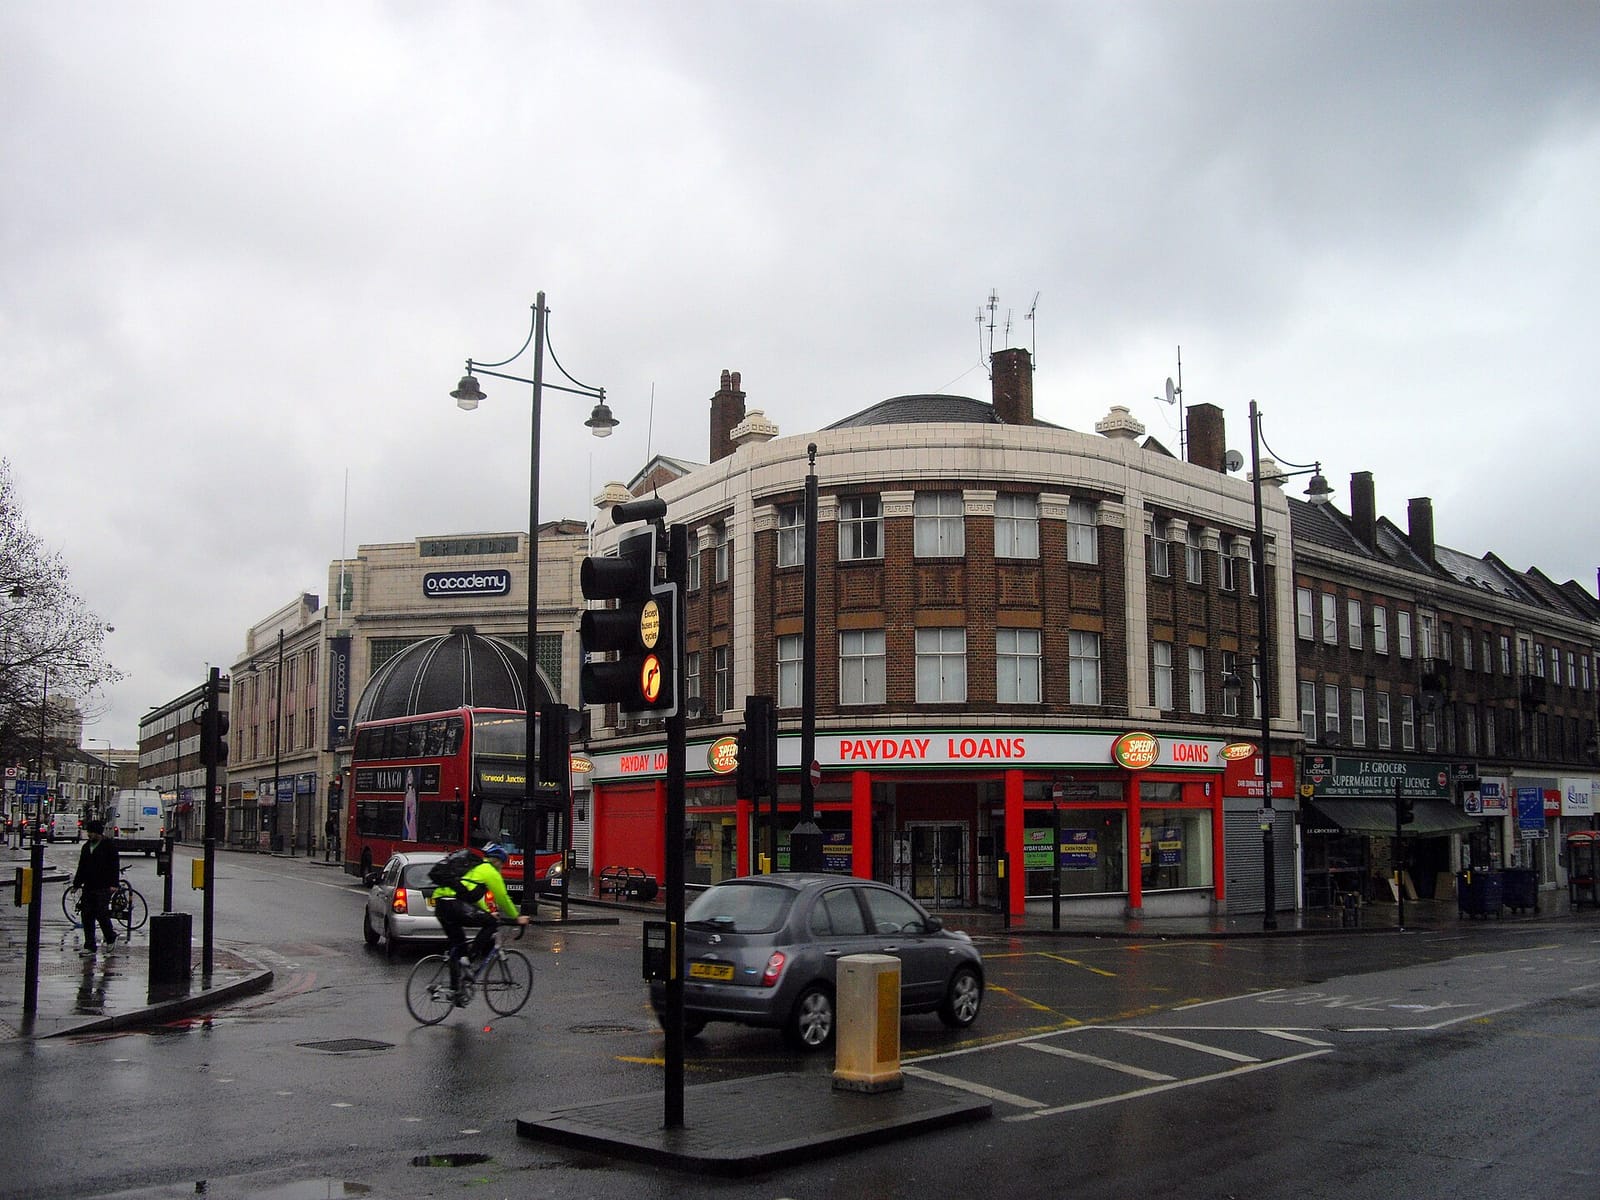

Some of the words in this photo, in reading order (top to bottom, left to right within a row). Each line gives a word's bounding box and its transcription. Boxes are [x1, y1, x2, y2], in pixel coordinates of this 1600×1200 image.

[840, 739, 930, 760] PAYDAY
[948, 738, 1026, 759] LOANS
[1129, 740, 1156, 753] SPEEDY
[1173, 743, 1209, 763] LOANS
[1130, 752, 1153, 762] CASH
[621, 755, 649, 773] PAYDAY
[1372, 762, 1407, 774] GROCERS
[376, 771, 402, 789] MANGO
[1332, 776, 1382, 787] SUPERMARKET
[1384, 777, 1389, 787] &
[1405, 777, 1431, 789] LICENCE
[509, 859, 524, 867] Lond
